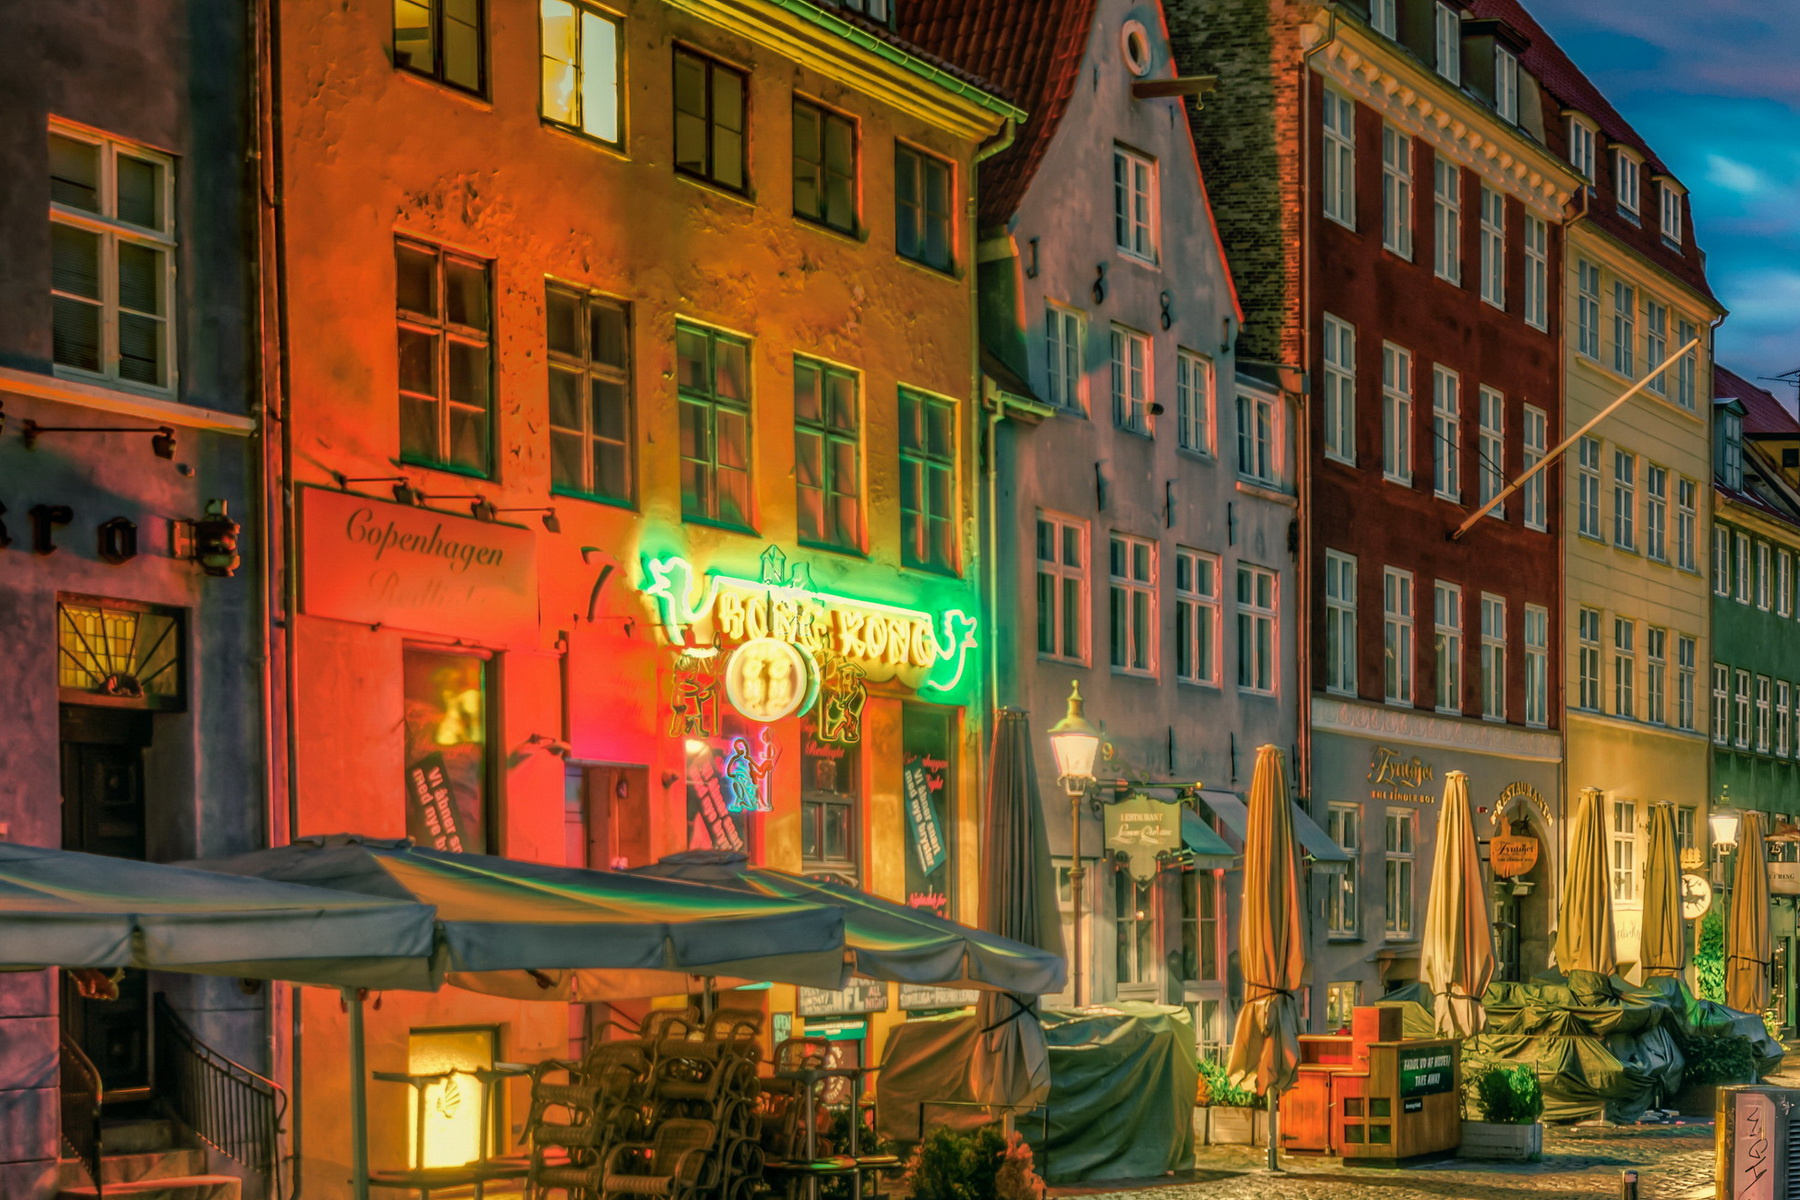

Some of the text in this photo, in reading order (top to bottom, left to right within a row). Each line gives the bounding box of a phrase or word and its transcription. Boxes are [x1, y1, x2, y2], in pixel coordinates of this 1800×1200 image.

[346, 508, 503, 573] Copenhagen
[835, 608, 937, 668] KONG
[1102, 742, 1114, 761] 9
[1496, 781, 1550, 817] RESTAURANT
[833, 986, 865, 1011] NFL
[868, 985, 881, 996] ALL
[1415, 1074, 1427, 1087] TAKE
